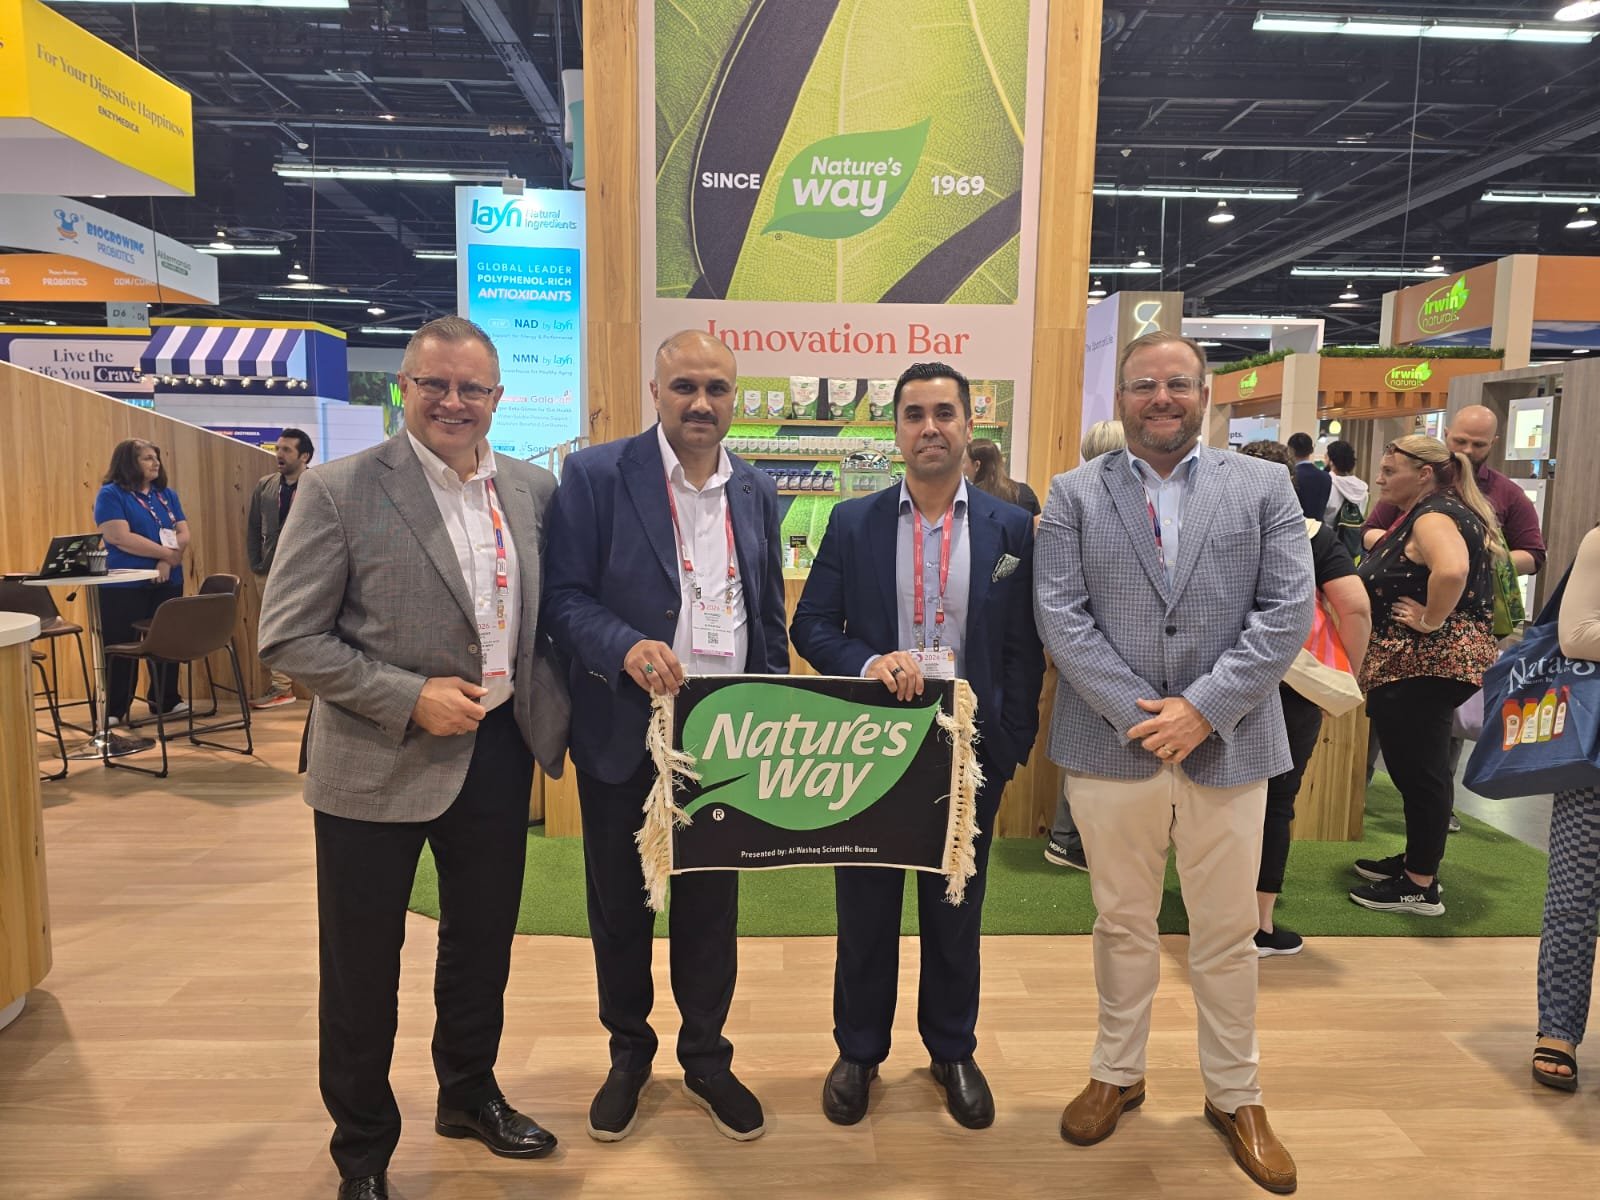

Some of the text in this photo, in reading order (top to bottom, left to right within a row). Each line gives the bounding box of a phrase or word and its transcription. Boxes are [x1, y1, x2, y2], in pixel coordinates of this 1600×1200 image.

[37, 43, 185, 138] For Your Digestive Happiness
[97, 105, 140, 134] ENZYMEDICA
[810, 156, 902, 176] Nature's
[702, 172, 760, 189] SINCE
[931, 175, 985, 195] 1969
[793, 177, 887, 217] way
[471, 199, 522, 233] layn
[525, 219, 577, 231] Ingredients
[86, 222, 145, 255] BIOGROWING
[96, 242, 135, 264] PROBIOTICS
[477, 262, 572, 274] GLOBAL LEADER
[477, 274, 572, 286] POLYPHENOL-RICH
[478, 287, 572, 302] ANTIOXIDANTS
[1424, 292, 1459, 315] irwin
[514, 319, 538, 328] NAD
[707, 319, 970, 355] Innovation Bar
[53, 349, 113, 363] Live the
[513, 354, 539, 363] NMN
[29, 366, 58, 380] ife
[61, 367, 90, 381] You
[1391, 368, 1422, 379] irwin
[701, 711, 914, 761] Nature's
[758, 758, 875, 811] Way
[741, 850, 775, 858] Presented
[777, 849, 787, 857] by:
[822, 845, 853, 853] Scientific
[855, 845, 878, 853] Bureau
[1049, 841, 1067, 856] HOKA
[1400, 894, 1426, 903] HOKA
